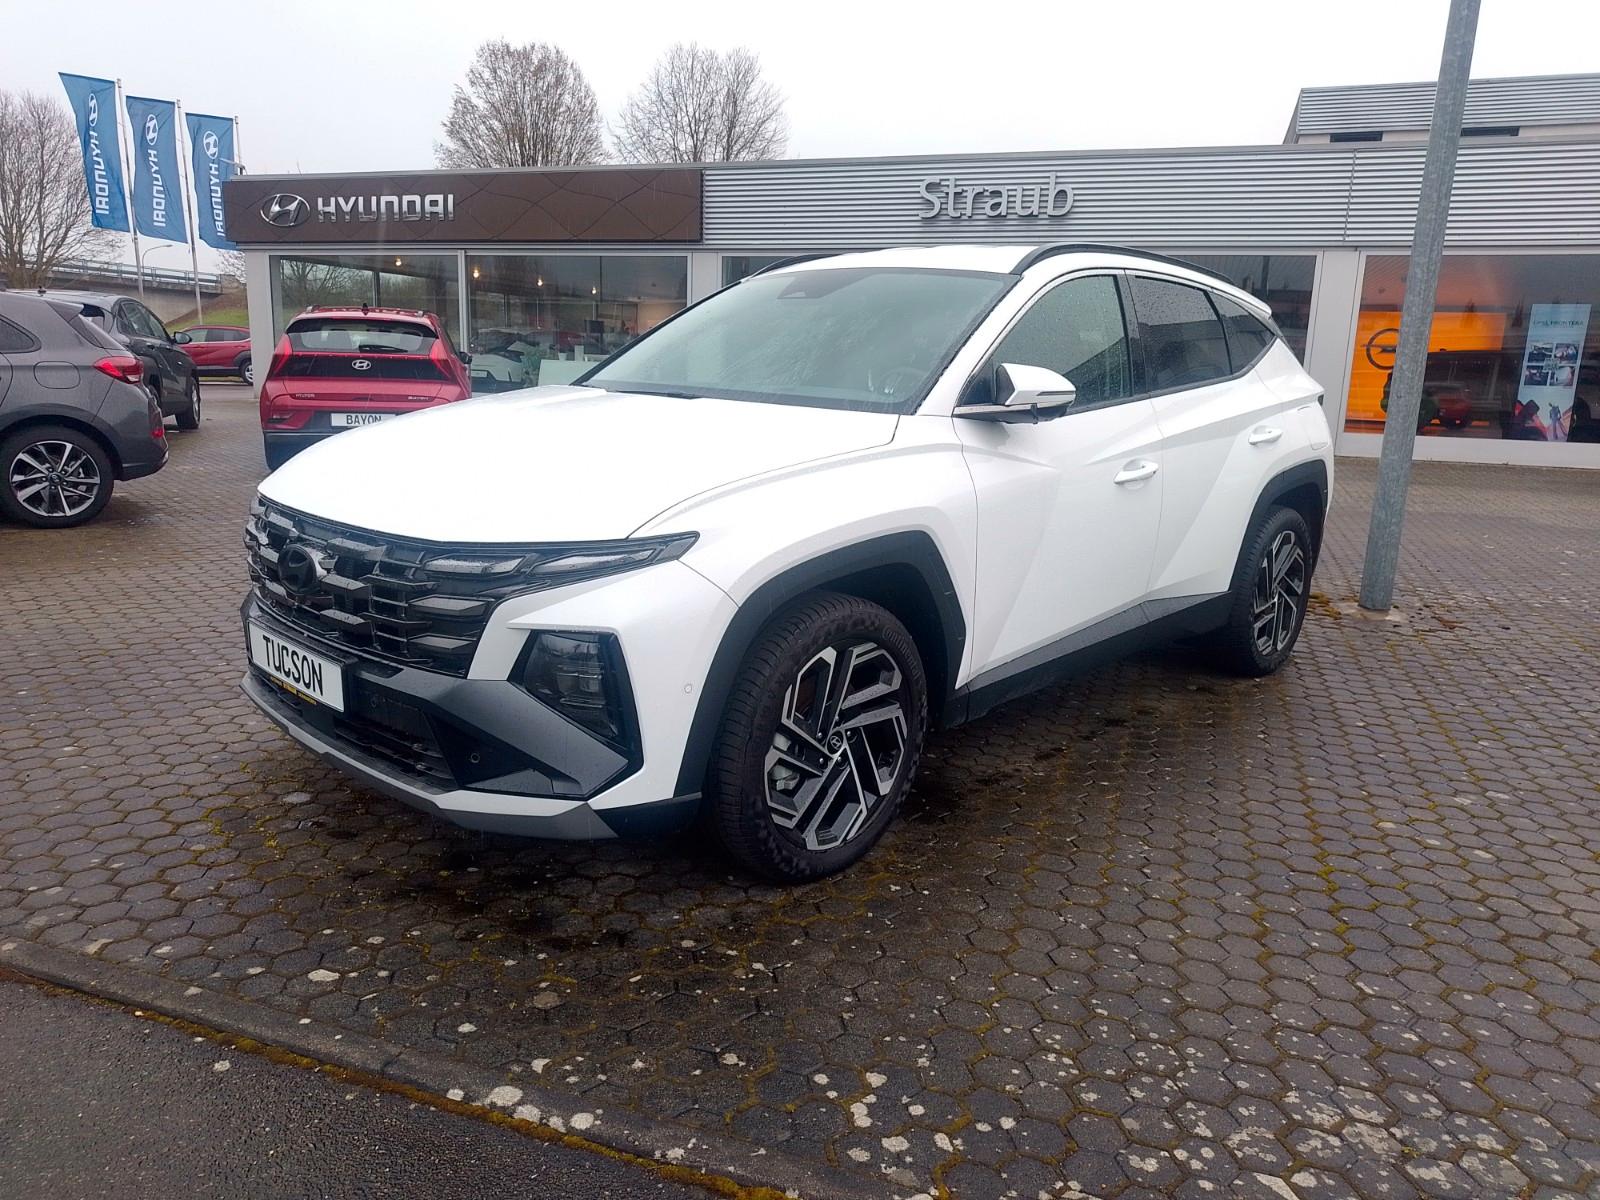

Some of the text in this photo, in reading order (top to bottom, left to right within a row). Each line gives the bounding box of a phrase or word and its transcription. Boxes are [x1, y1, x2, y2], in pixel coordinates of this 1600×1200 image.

[89, 131, 110, 215] HYUNDAI
[148, 149, 166, 227] HYUNDAI
[209, 163, 226, 237] HYUNDAI
[918, 172, 1074, 219] Straub
[317, 193, 455, 223] HYUNDAI
[346, 414, 382, 425] BAYON
[262, 634, 324, 697] TUCSON
